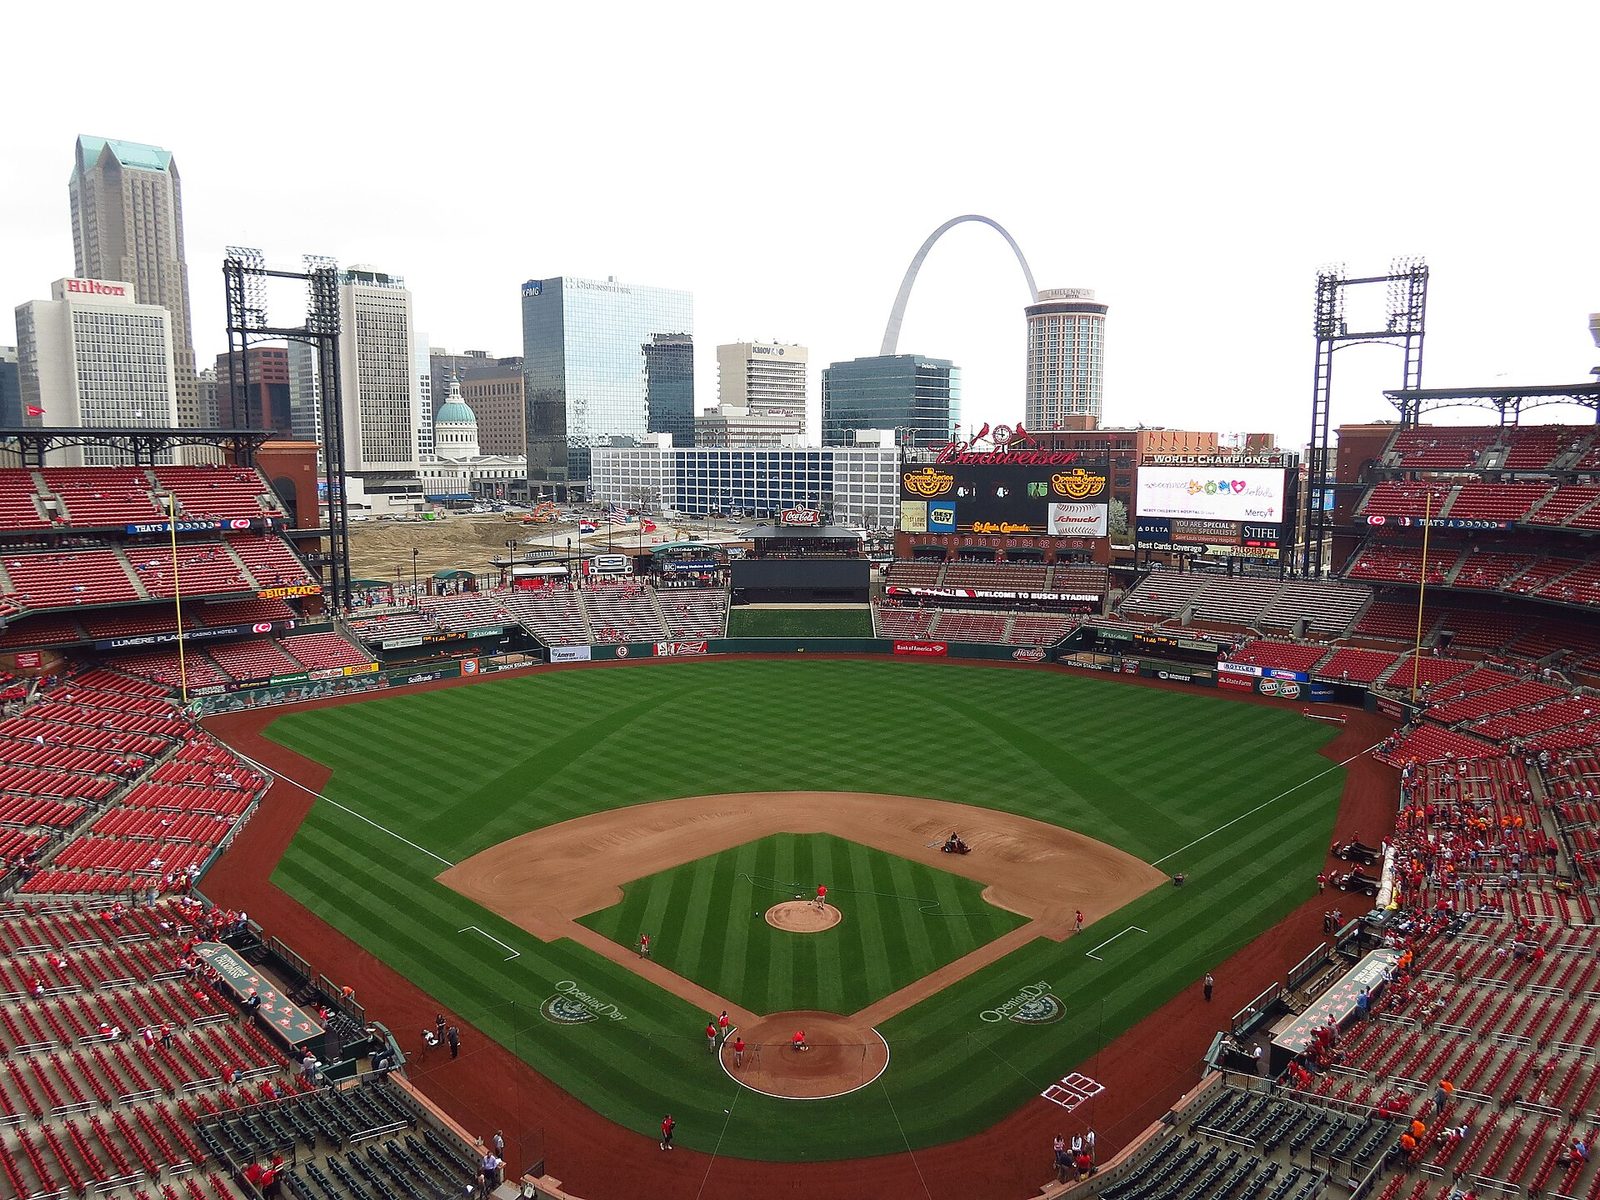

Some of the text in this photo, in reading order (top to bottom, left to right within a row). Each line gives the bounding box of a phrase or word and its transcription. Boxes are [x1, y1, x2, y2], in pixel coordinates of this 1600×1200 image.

[67, 280, 126, 297] Hilton
[522, 286, 541, 297] KPMG
[928, 441, 1078, 465] Budweiser
[1153, 454, 1269, 465] WORLD CHAMPIONS
[1245, 509, 1268, 519] Mercy
[135, 523, 163, 533] THAT'S
[1203, 522, 1229, 530] SPECIAL
[1198, 528, 1237, 536] SPECIALISTS
[1244, 525, 1280, 540] STIFEL
[1138, 541, 1202, 554] Best Cards Coverage
[266, 586, 315, 599] BIG MAC
[976, 590, 1099, 602] WELCOME TO BUSCH STADIUM
[192, 630, 212, 639] CASINO
[217, 628, 238, 637] HOTELS
[498, 660, 533, 671] BUSCH STADIUM
[1083, 662, 1102, 670] STADIUM
[408, 673, 434, 684] Scottrade
[1226, 677, 1252, 687] State Farm
[1260, 684, 1278, 692] Gulf
[1280, 686, 1299, 694] Gulf
[555, 980, 628, 1021] Opening Day
[980, 980, 1052, 1023] Opening Day
